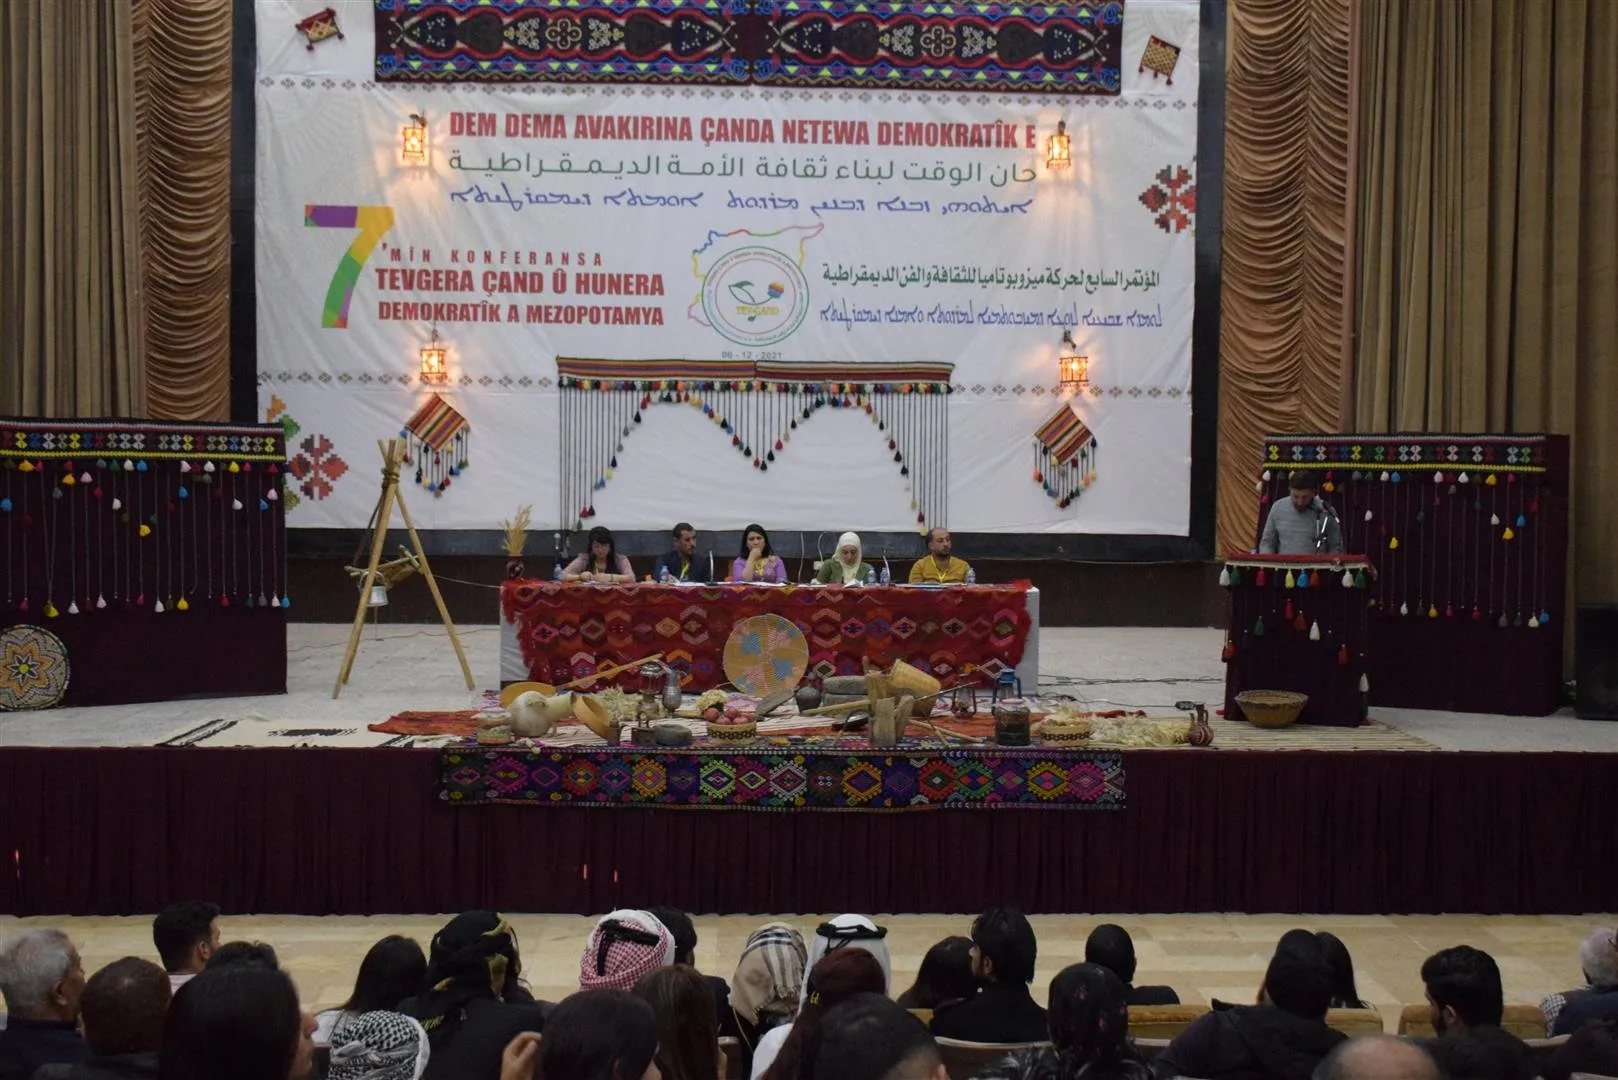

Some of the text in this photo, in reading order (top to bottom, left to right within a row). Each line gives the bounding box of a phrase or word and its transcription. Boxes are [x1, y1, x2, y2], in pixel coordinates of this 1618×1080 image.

[451, 112, 1037, 148] DEM DEMA AVAKIRINA ÇANDA NETEWA DEMOKRATÎK E
[449, 150, 1037, 188] حان الوقت لبناء ثقافة الأمة الديمقراطية
[304, 205, 394, 328] 7
[451, 250, 601, 266] KONFERANSA
[375, 268, 664, 297] TEVGERA ÇAND Û HUNERA
[823, 264, 899, 287] الديمقراطية
[899, 265, 931, 288] والفن
[932, 265, 976, 283] للثقافة
[978, 268, 1044, 289] ميزوبوتاميا
[1046, 268, 1084, 290] لحركة
[1085, 270, 1122, 294] السابع
[1123, 269, 1159, 291] المؤتمر
[379, 300, 664, 325] DEMOKRATÎK A MEZOPOTAMYA
